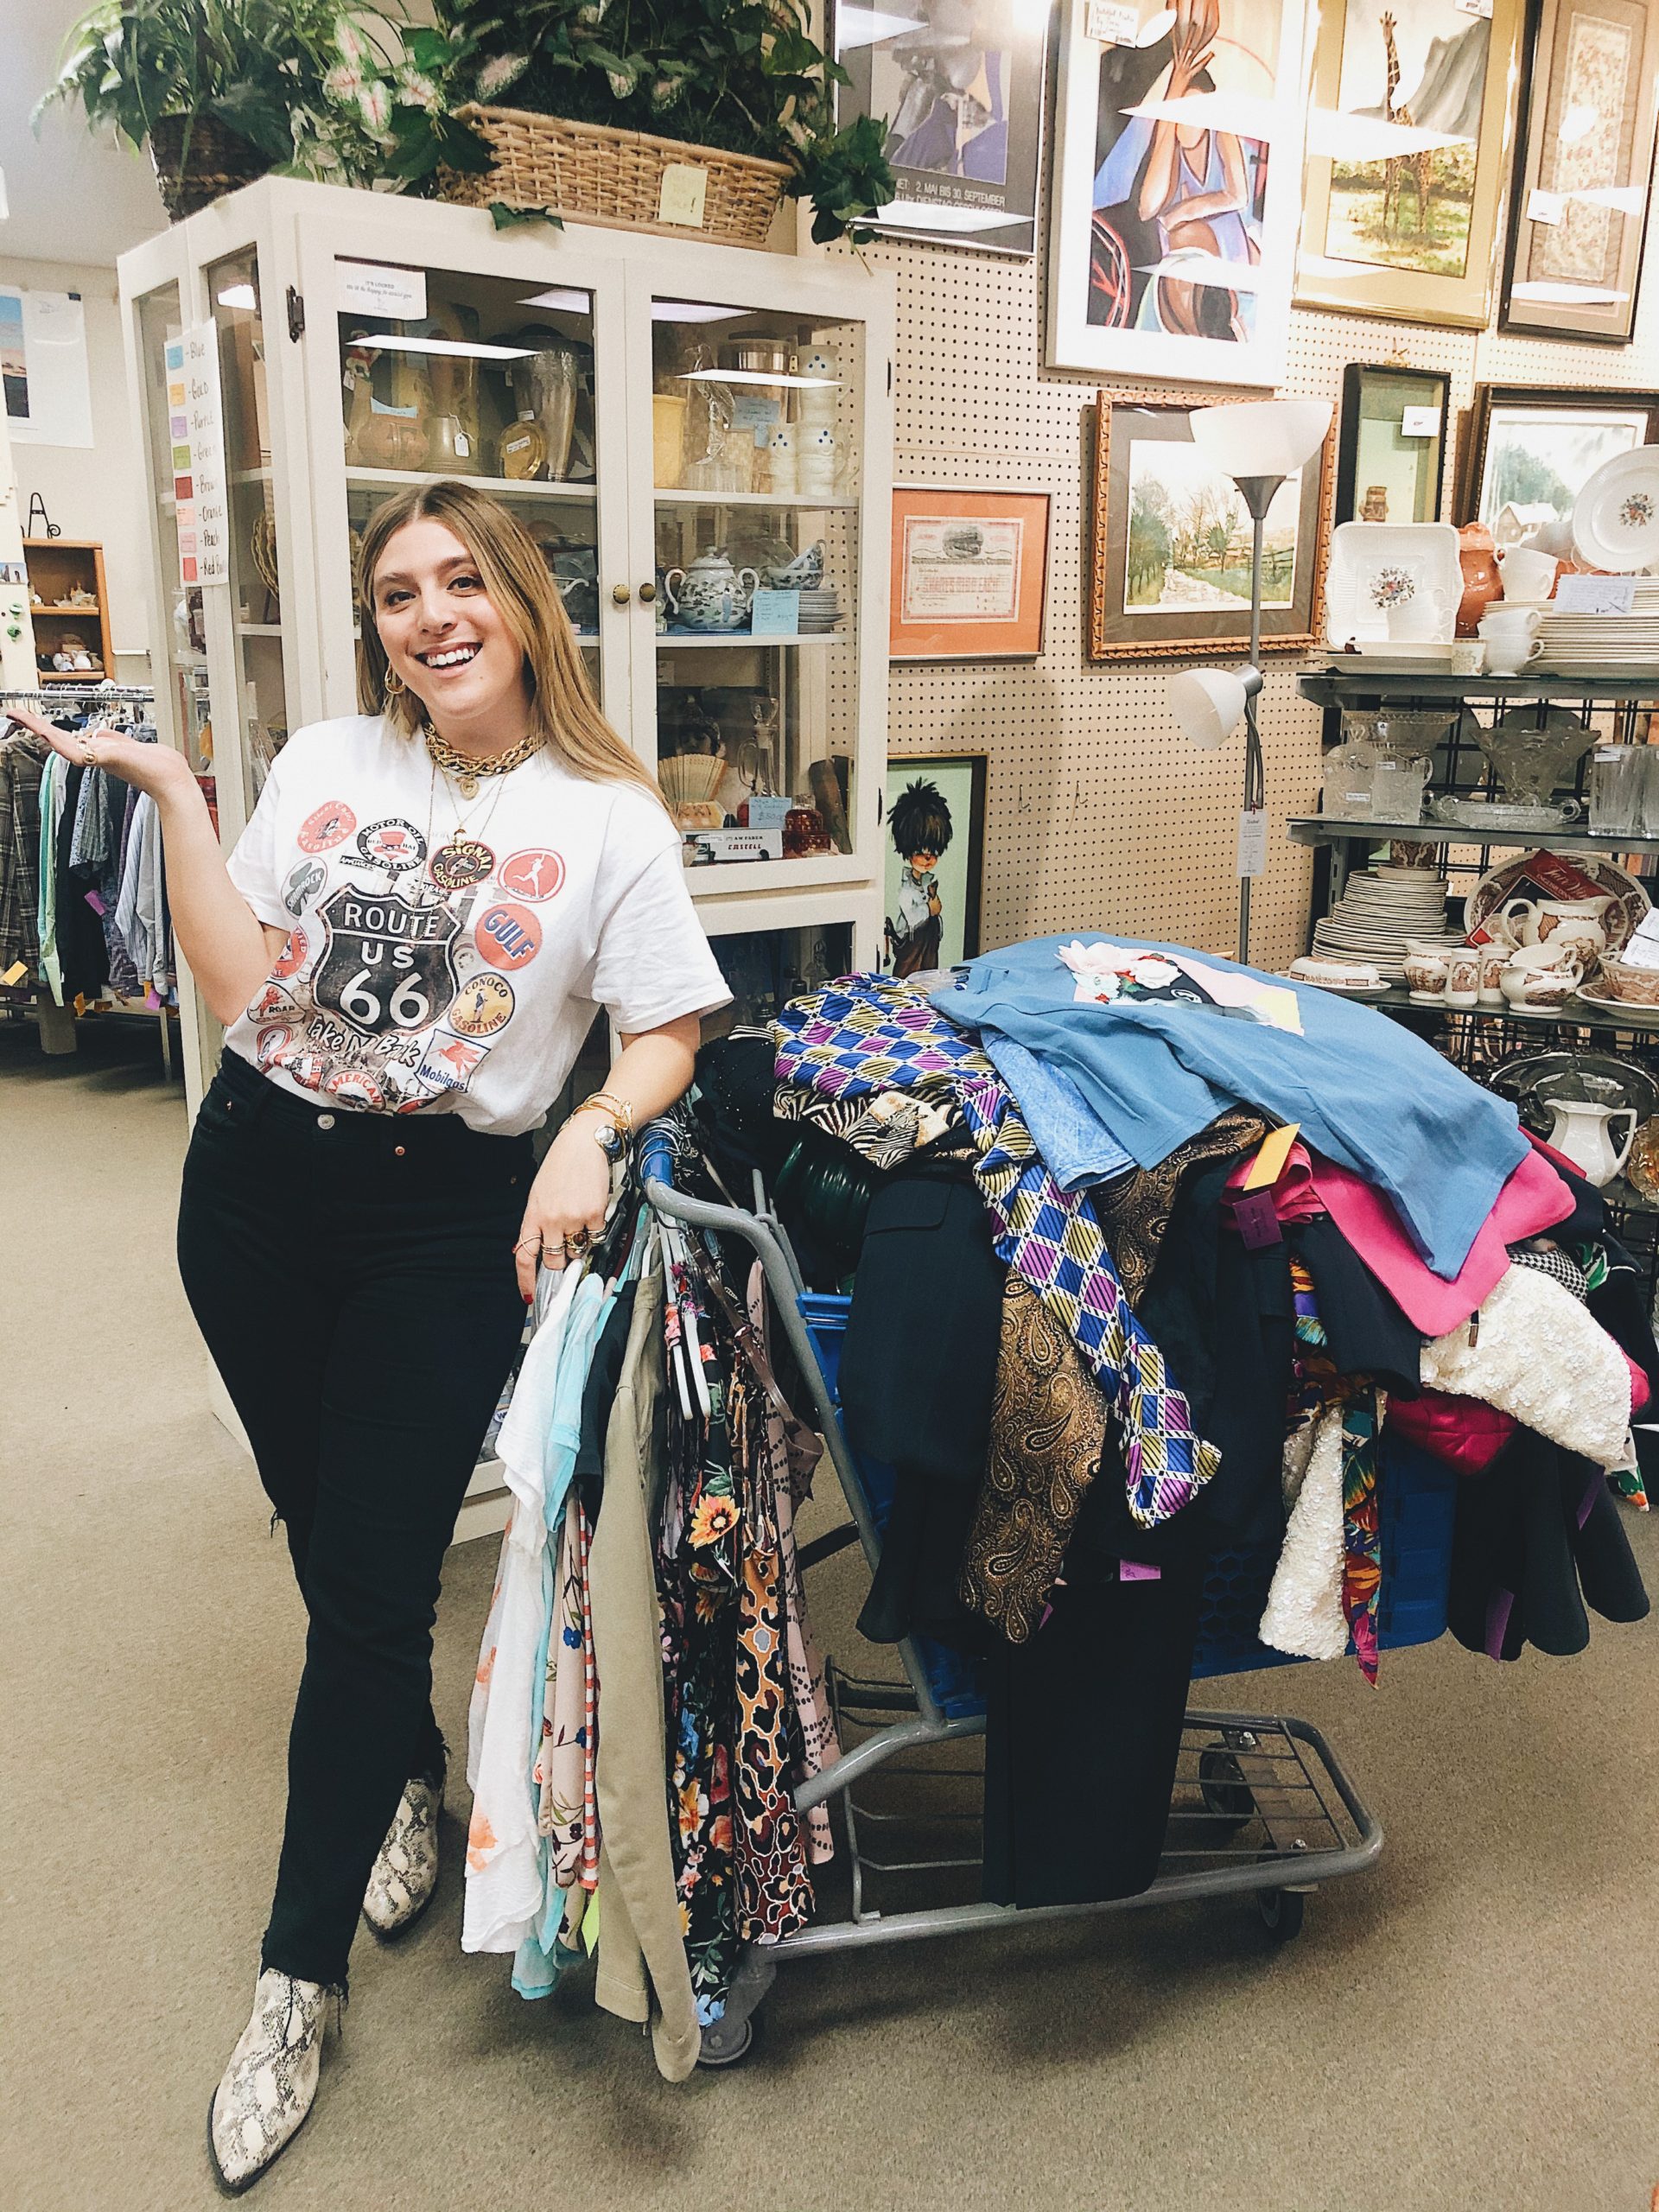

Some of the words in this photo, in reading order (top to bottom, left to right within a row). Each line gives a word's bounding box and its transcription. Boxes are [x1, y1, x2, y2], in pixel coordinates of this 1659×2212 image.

[924, 182, 938, 195] MAI
[939, 185, 951, 198] BIS
[963, 189, 1006, 207] SEPTEMBER
[361, 819, 405, 837] MOTOR
[408, 826, 423, 844] OIL
[360, 846, 423, 870] GASOLINE
[442, 843, 493, 872] SIGNAL
[433, 862, 479, 889] GASOLINE
[287, 870, 322, 909] SHAMROCK
[344, 902, 440, 938] ROUTE
[484, 909, 536, 961] GULF
[340, 968, 430, 1028] 66
[464, 976, 509, 999] CONOCO
[269, 1005, 296, 1014] ROAR
[451, 1007, 507, 1034] GASOLINE
[326, 1071, 385, 1106] AMERICAN
[419, 1064, 466, 1091] Mobilgas
